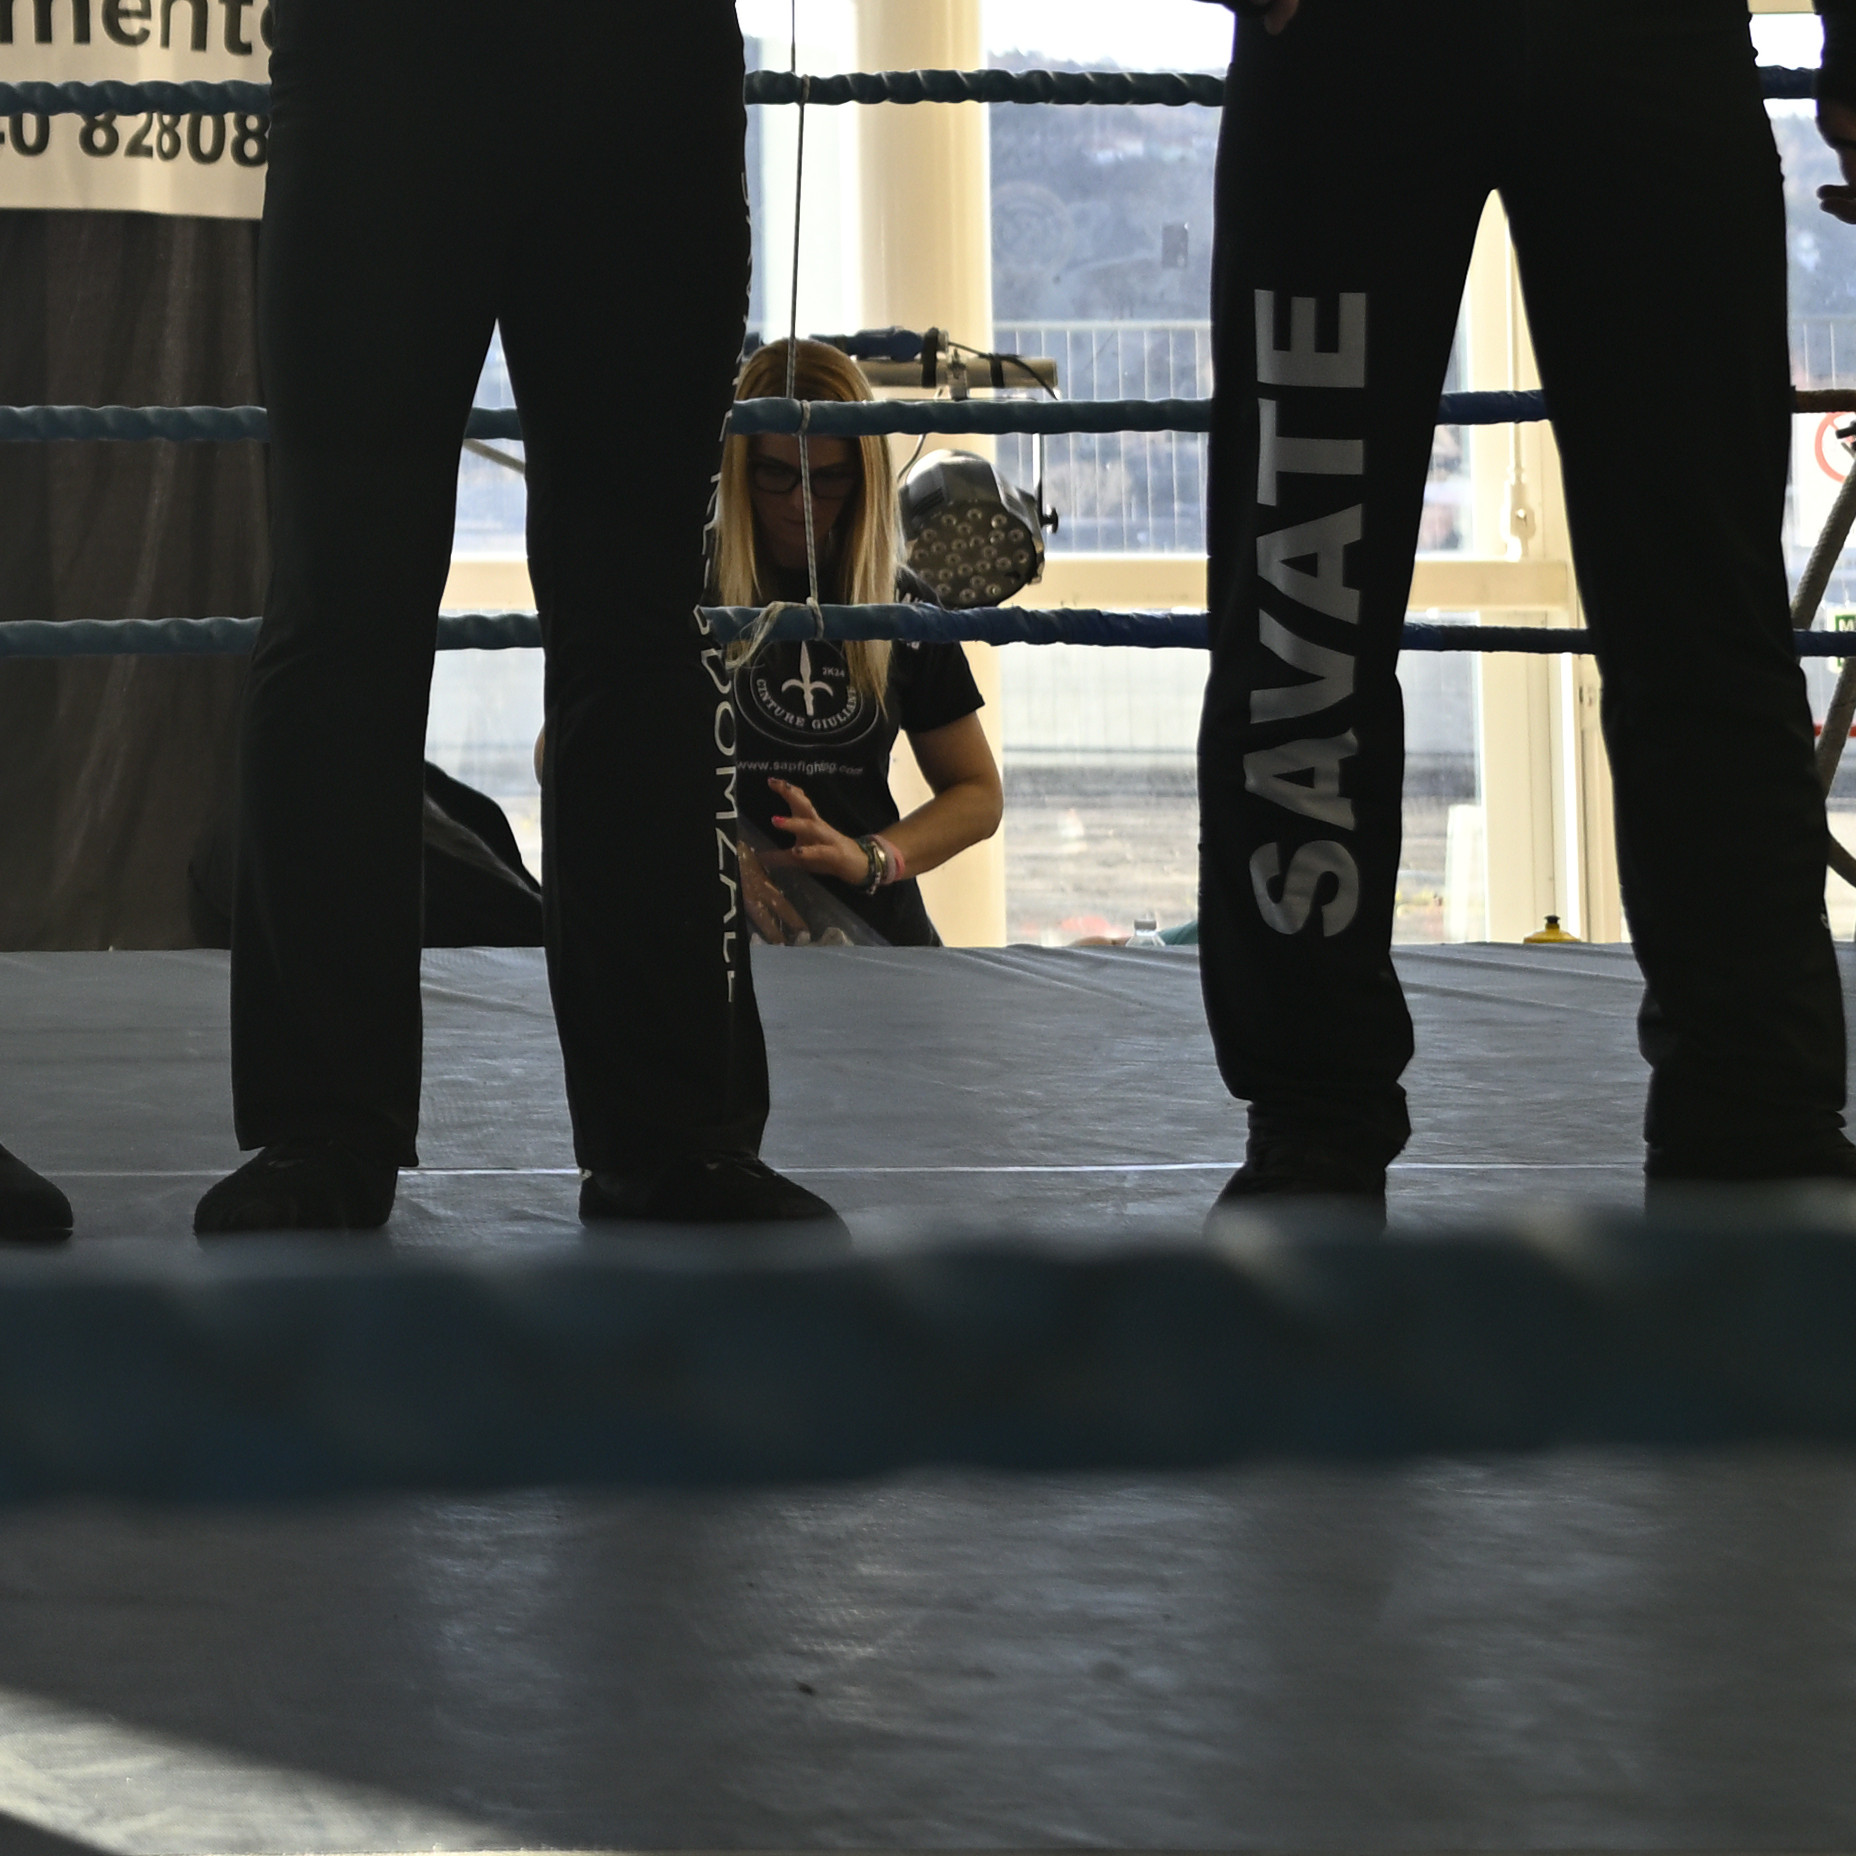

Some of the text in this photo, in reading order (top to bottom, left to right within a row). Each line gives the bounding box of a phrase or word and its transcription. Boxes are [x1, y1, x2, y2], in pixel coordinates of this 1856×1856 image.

[78, 111, 269, 168] 82808
[1242, 287, 1369, 938] SAVATE
[756, 679, 806, 728] CINTURE
